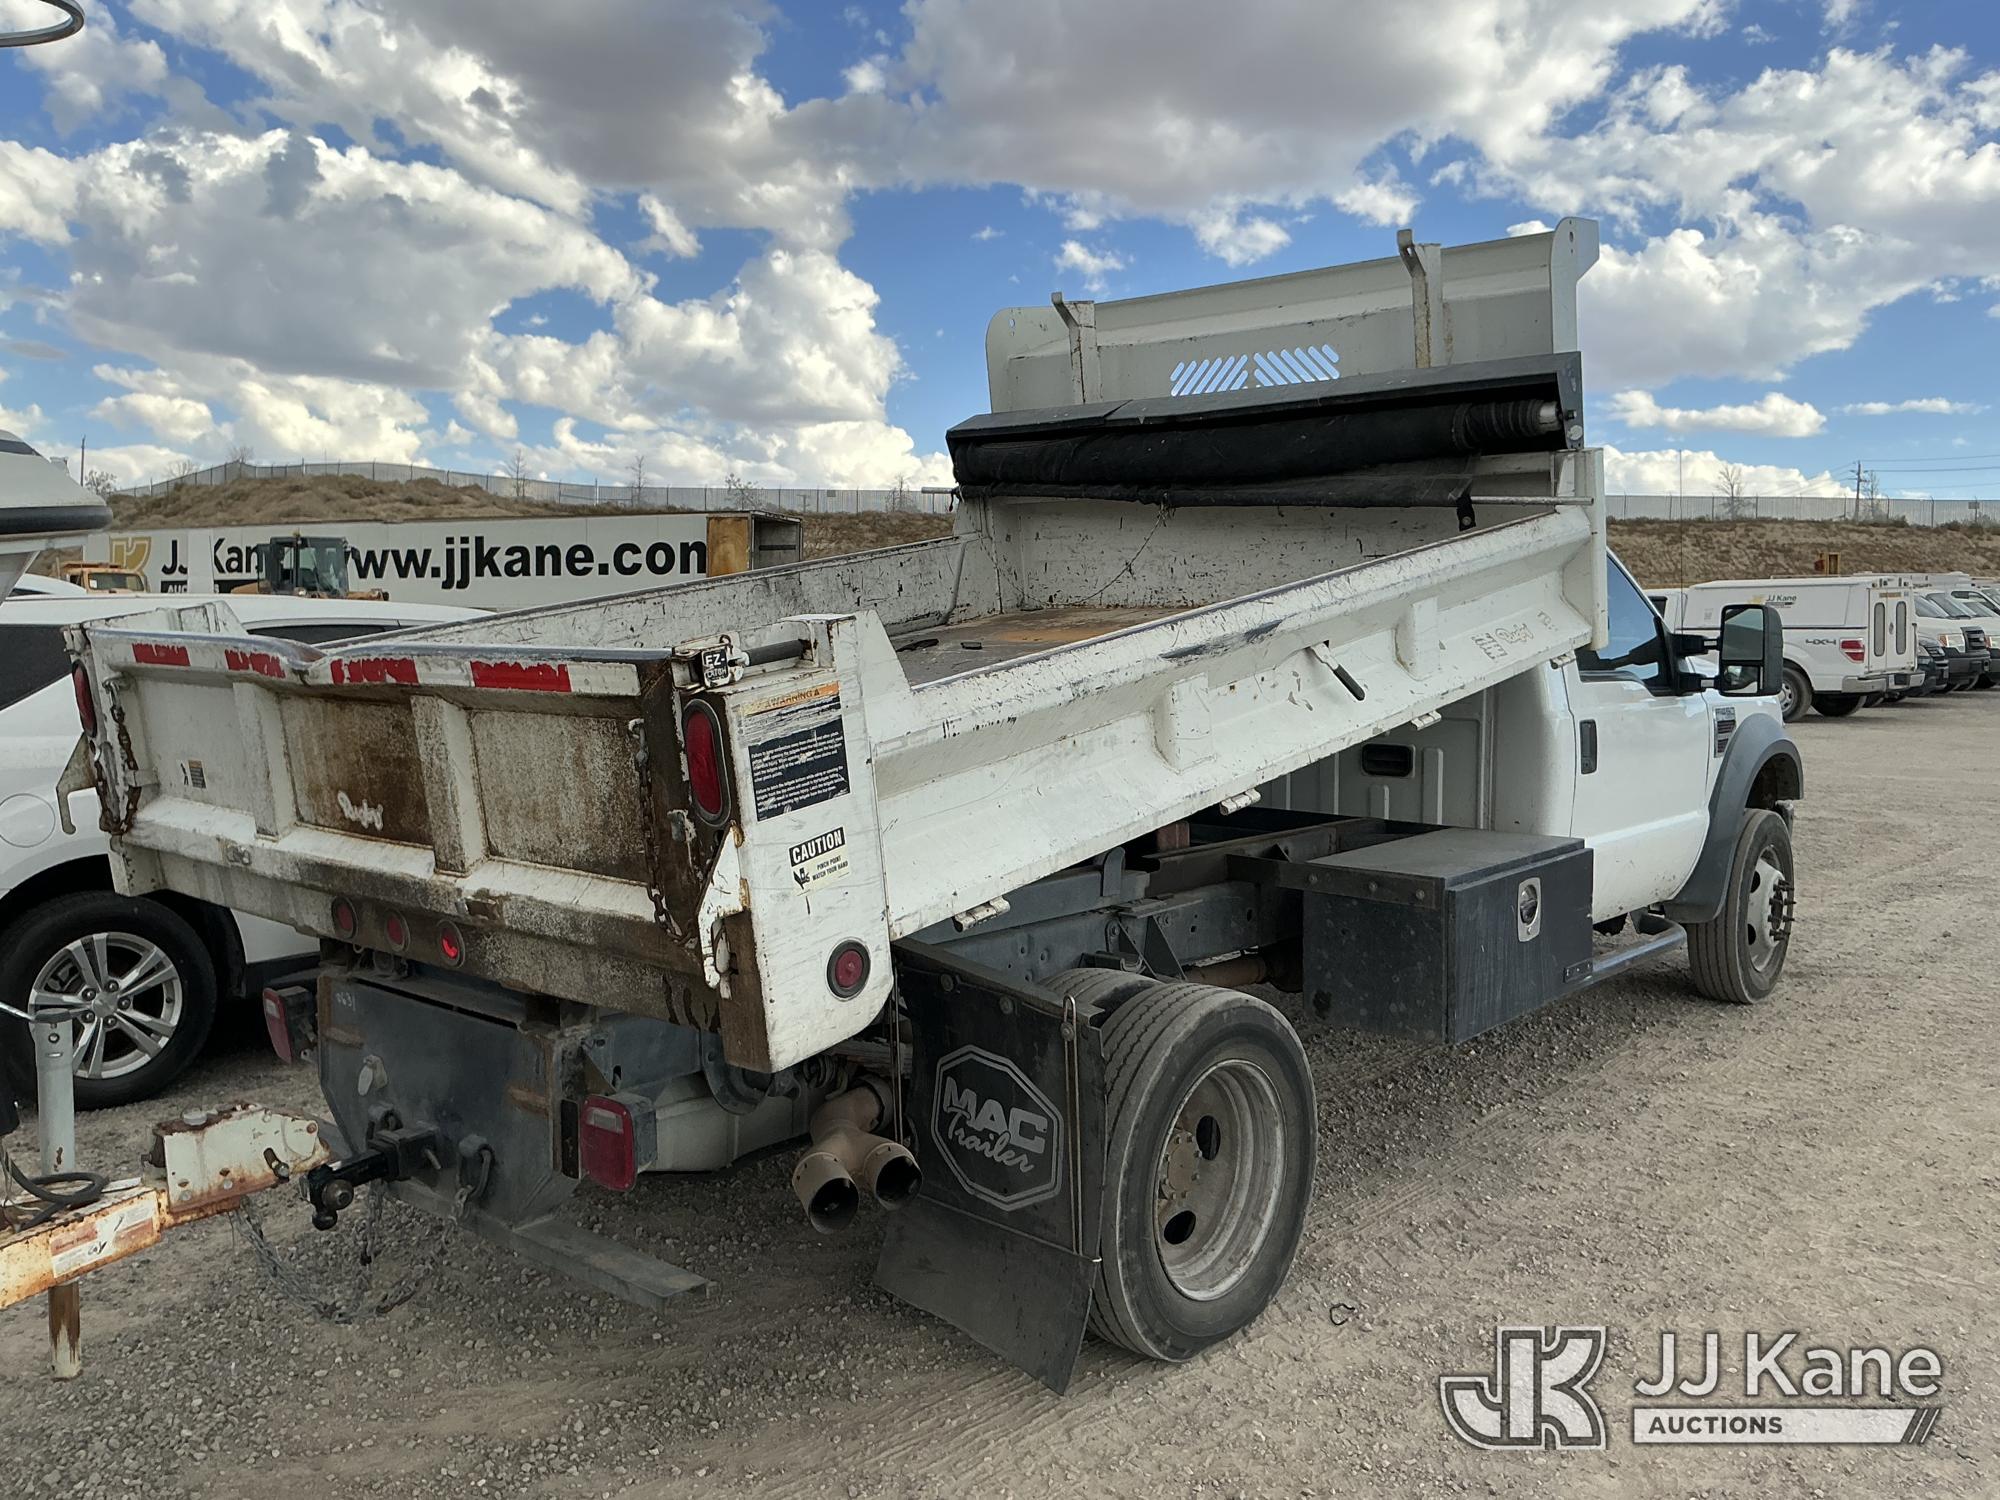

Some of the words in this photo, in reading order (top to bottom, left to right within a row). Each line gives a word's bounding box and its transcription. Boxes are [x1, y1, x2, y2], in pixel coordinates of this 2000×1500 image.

[344, 535, 707, 590] ww.jjkane.com
[792, 829, 842, 864] CAUTION
[817, 860, 830, 870] PINCH
[943, 1076, 1048, 1154] MAC
[946, 1106, 1035, 1173] Trailer
